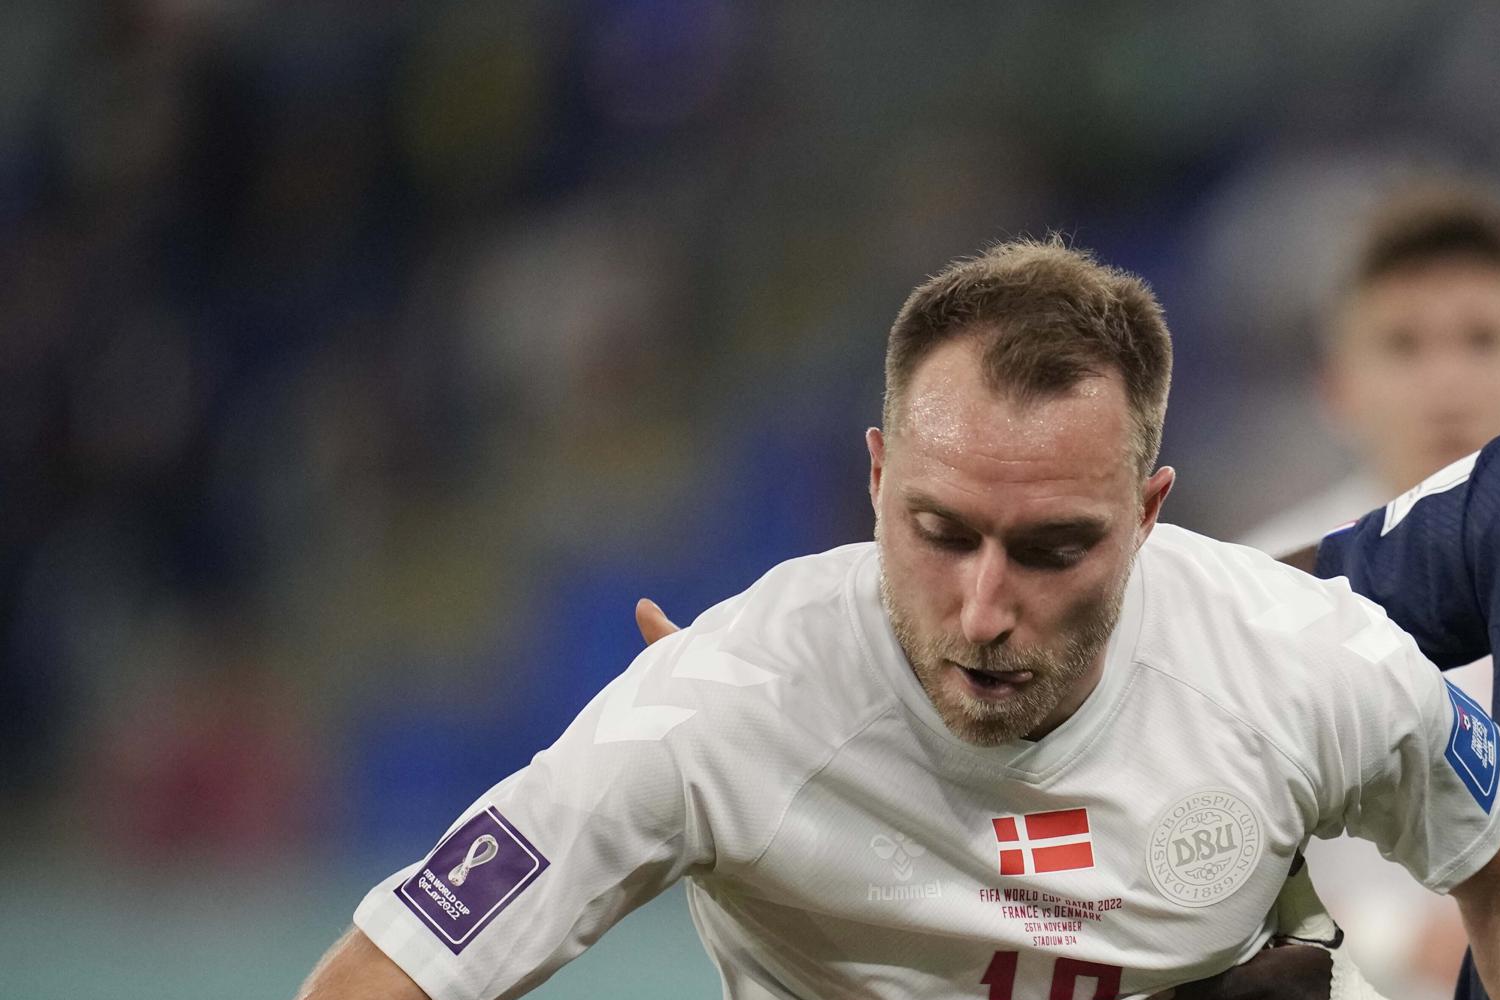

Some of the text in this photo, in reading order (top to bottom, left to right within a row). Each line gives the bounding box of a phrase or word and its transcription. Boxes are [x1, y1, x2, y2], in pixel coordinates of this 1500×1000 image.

[1172, 822, 1238, 868] DBU
[422, 868, 471, 915] FIFA WORLD CUP
[867, 879, 942, 901] hummel
[979, 887, 1001, 902] FIFA
[1003, 887, 1039, 902] WORLD
[1097, 897, 1123, 912] 2022
[1001, 904, 1039, 919] FRANCE
[1054, 904, 1102, 922] DENMARK
[1024, 920, 1082, 933] 26TH NOVEMBER
[1033, 935, 1077, 947] STADIUM 974
